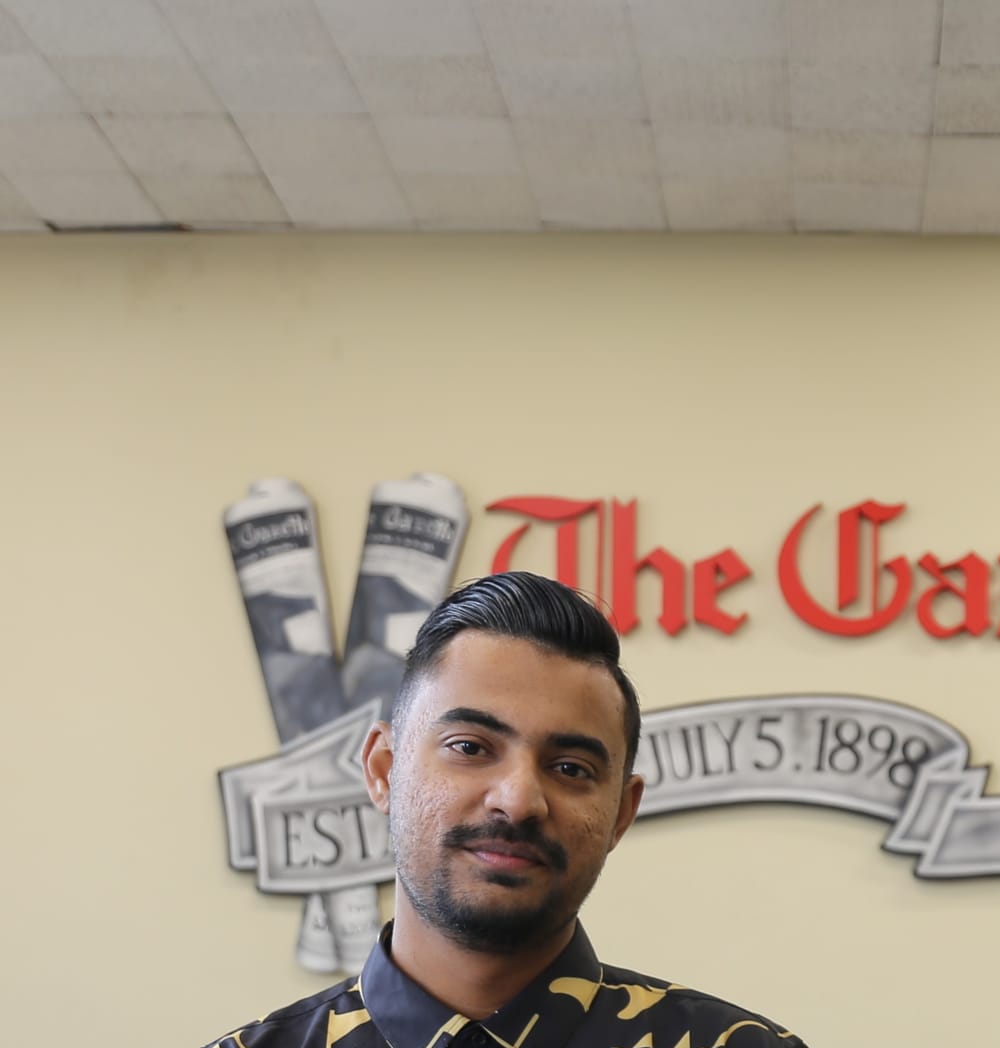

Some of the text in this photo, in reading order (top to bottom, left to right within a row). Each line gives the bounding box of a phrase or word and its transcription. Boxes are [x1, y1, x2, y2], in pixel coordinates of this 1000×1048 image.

[485, 495, 753, 637] The
[645, 717, 744, 788] JULY
[815, 716, 932, 790] 1898
[282, 803, 389, 868] EST
